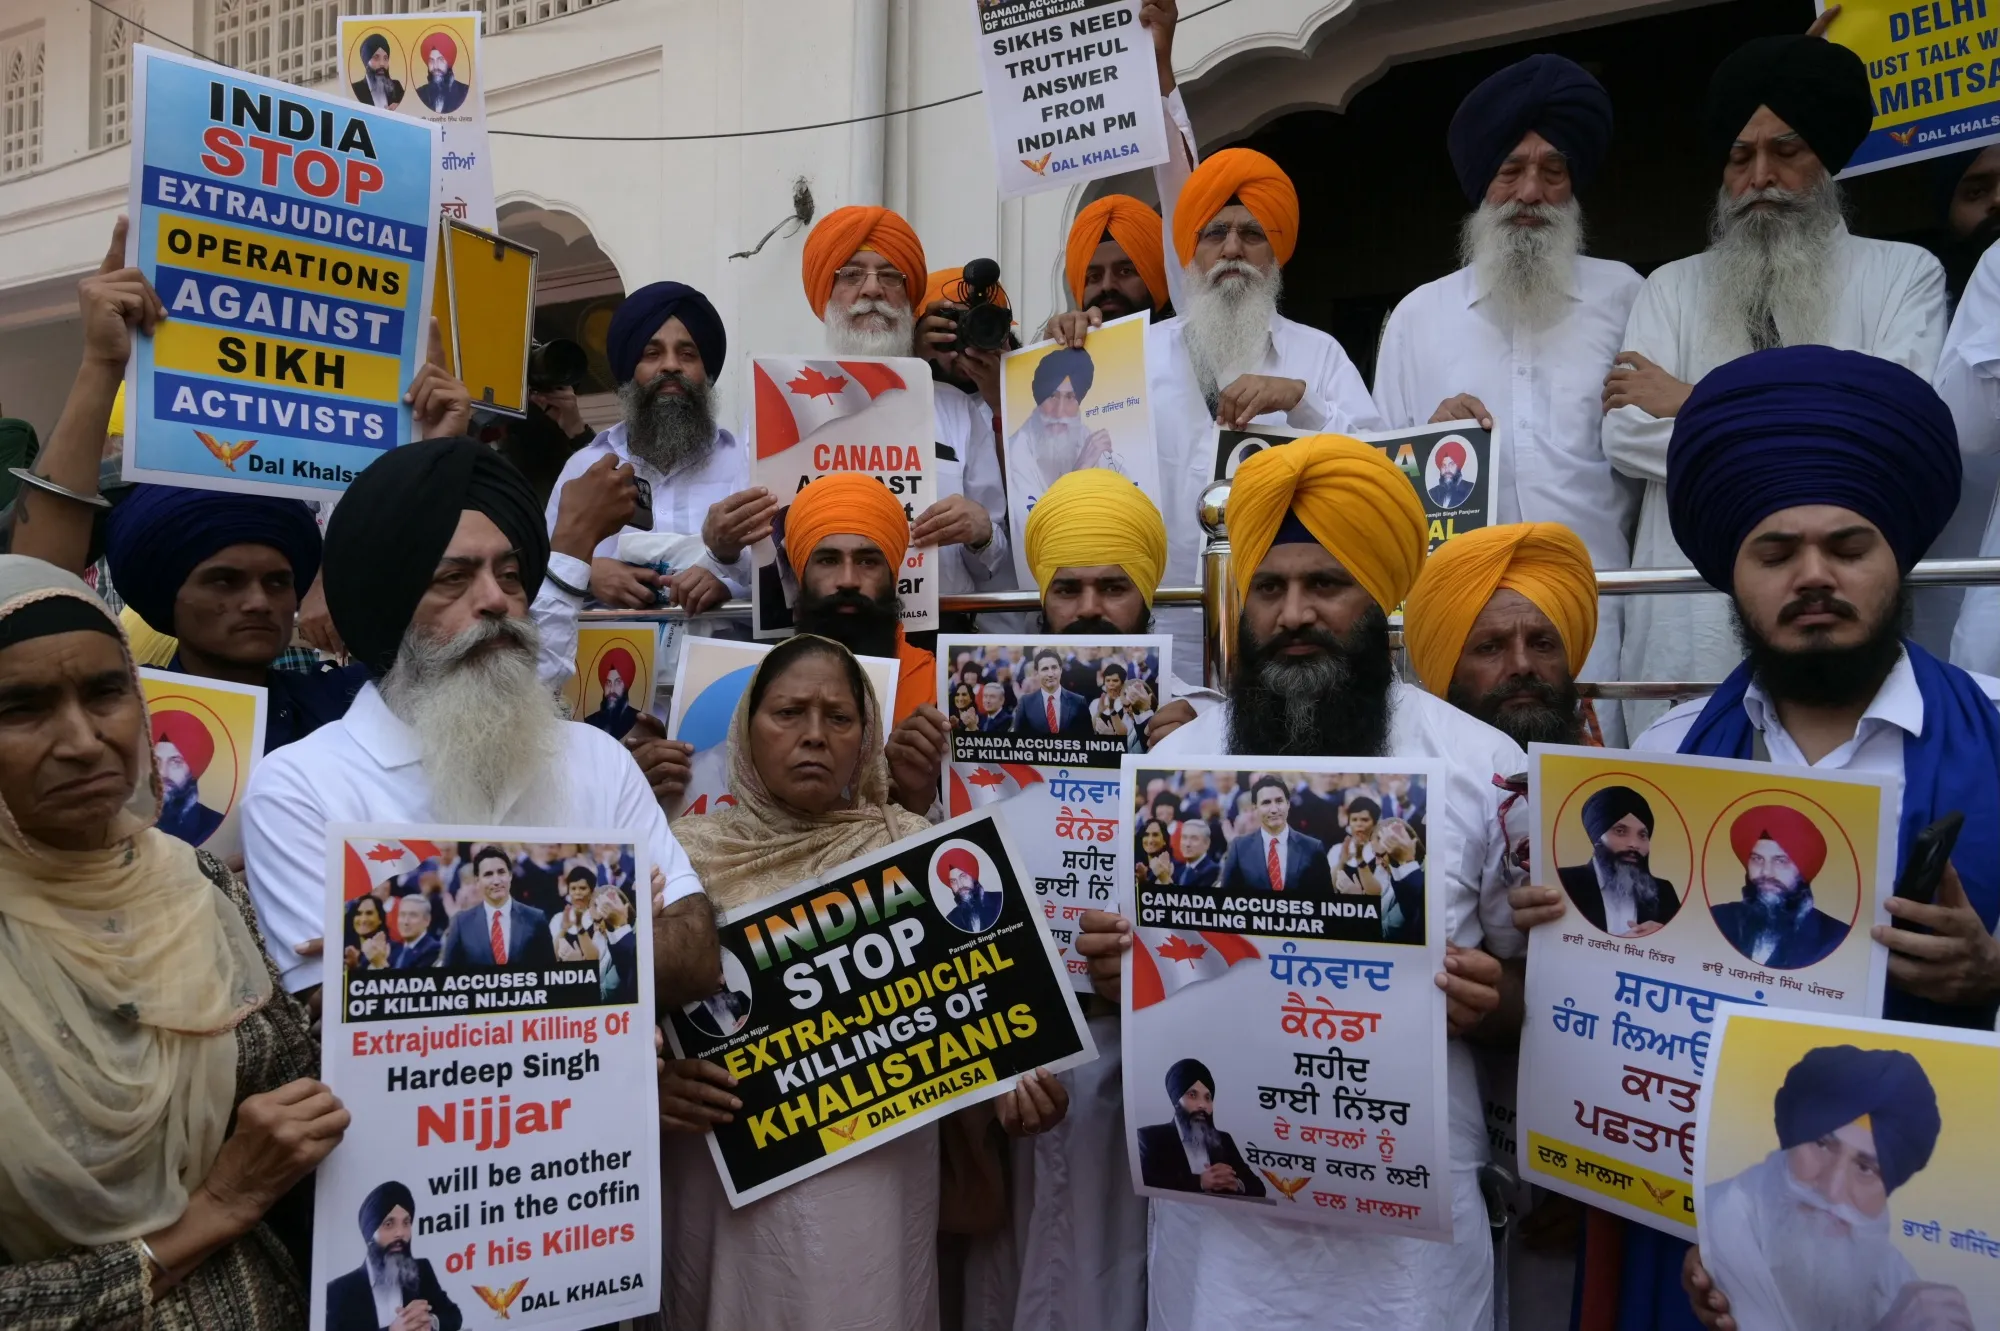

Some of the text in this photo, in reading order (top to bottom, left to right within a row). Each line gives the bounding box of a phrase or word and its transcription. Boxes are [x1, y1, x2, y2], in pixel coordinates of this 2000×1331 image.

[983, 3, 1026, 21] CANADA
[985, 20, 999, 31] OF
[1001, 10, 1044, 27] KILLING
[1046, 1, 1086, 16] NIJJAR
[993, 9, 1133, 56] SIKHS NEED
[1889, 0, 1987, 43] DELHI
[1005, 38, 1128, 79] TRUTHFUL
[1864, 52, 1910, 79] UST
[1916, 36, 1971, 67] TALK
[1022, 65, 1119, 102] ANSWER
[208, 81, 378, 160] INDIA
[1041, 93, 1105, 122] FROM
[1918, 115, 2000, 143] DAL KHALS
[1017, 111, 1137, 154] INDIAN PM
[200, 126, 384, 207] STOP
[1052, 143, 1140, 173] DAL KHALSA
[158, 175, 413, 253] EXTRAJUDICIAL
[167, 228, 401, 296] OPERATIONS
[172, 278, 391, 345] AGAINST
[217, 336, 346, 389] SIKH
[171, 386, 384, 440] ACTIVISTS
[249, 454, 360, 483] Dal Khals
[813, 444, 922, 471] CANADA
[1425, 510, 1441, 519] ramjit
[1443, 510, 1458, 518] Singh
[907, 551, 924, 568] of
[955, 736, 1126, 752] CANADA ACCUSES INDIA
[956, 748, 1088, 764] OF KILLING NIJJAR
[1049, 769, 1120, 804] ਧੰਨਵਾ
[1055, 806, 1119, 842] ਕੈਨੇਡ
[1062, 845, 1116, 872] ਸ਼ਹੀਦ
[1035, 872, 1079, 898] ਭਾਈ
[1141, 891, 1378, 920] CANADA ACCUSES INDIA
[744, 865, 927, 971] INDIA
[1044, 900, 1057, 919] ਦੇ
[1141, 907, 1325, 935] OF KILLING NIJJAR
[948, 921, 1024, 955] Paramjit Singh Panjwar
[1562, 933, 1676, 965] ਭਾਈ ਹਰਦੀਪ ਸਿੰਘ ਨਿੱਝਰ
[350, 967, 598, 997] CANADA ACCUSES INDIA
[783, 917, 926, 1010] STOP
[1268, 941, 1394, 992] ਧੰਨਵਾਦ
[1728, 967, 1775, 985] ਪਰਮਜੀਤ
[1780, 975, 1803, 991] ਸਿੰਘ
[348, 989, 548, 1017] OF KILLING NIJJAR
[723, 942, 1015, 1080] EXTRA-JUDICIAL
[1281, 991, 1382, 1042] ਕੈਨੇਡਾ
[1614, 971, 1768, 1024] ਸ਼ਹਾਦ
[352, 1011, 630, 1057] Extrajudicial Killing Of
[697, 1024, 770, 1059] Hardeep Singh Nijjar
[774, 983, 989, 1094] KILLINGS OF
[1552, 997, 1712, 1077] ਰੰਗ ਲਿਆਉ
[387, 1048, 600, 1092] Hardeep Singh
[747, 1003, 1039, 1150] KHALISTANIS
[1293, 1046, 1370, 1083] ਸ਼ਹੀਦ
[868, 1070, 988, 1129] DAL KHALSA
[1257, 1082, 1411, 1126] ਭਾਈ ਨਿੱਝਰ
[1621, 1064, 1702, 1113] ਕਾਤ
[417, 1094, 572, 1152] Nijjar
[1274, 1116, 1396, 1163] ਦੇ ਕਾਤਲਾਂ ਨੂੰ
[1573, 1099, 1696, 1176] ਪਛਤਾਉ
[428, 1148, 632, 1196] will be another
[1245, 1142, 1431, 1189] ਬੇਨਕਾਬ ਕਰਨ ਲਈ
[1538, 1144, 1634, 1190] ਦਲ ਖ਼ਾਲਸਾ
[418, 1180, 640, 1236] nail in the coffin
[1312, 1191, 1421, 1220] ਦਲ ਖ਼ਾਲਸਾ
[445, 1220, 635, 1274] of his Killers
[1902, 1218, 2000, 1259] ਭਾਈ ਗਜਿੰਦ
[521, 1273, 644, 1314] DAL KHALSA
